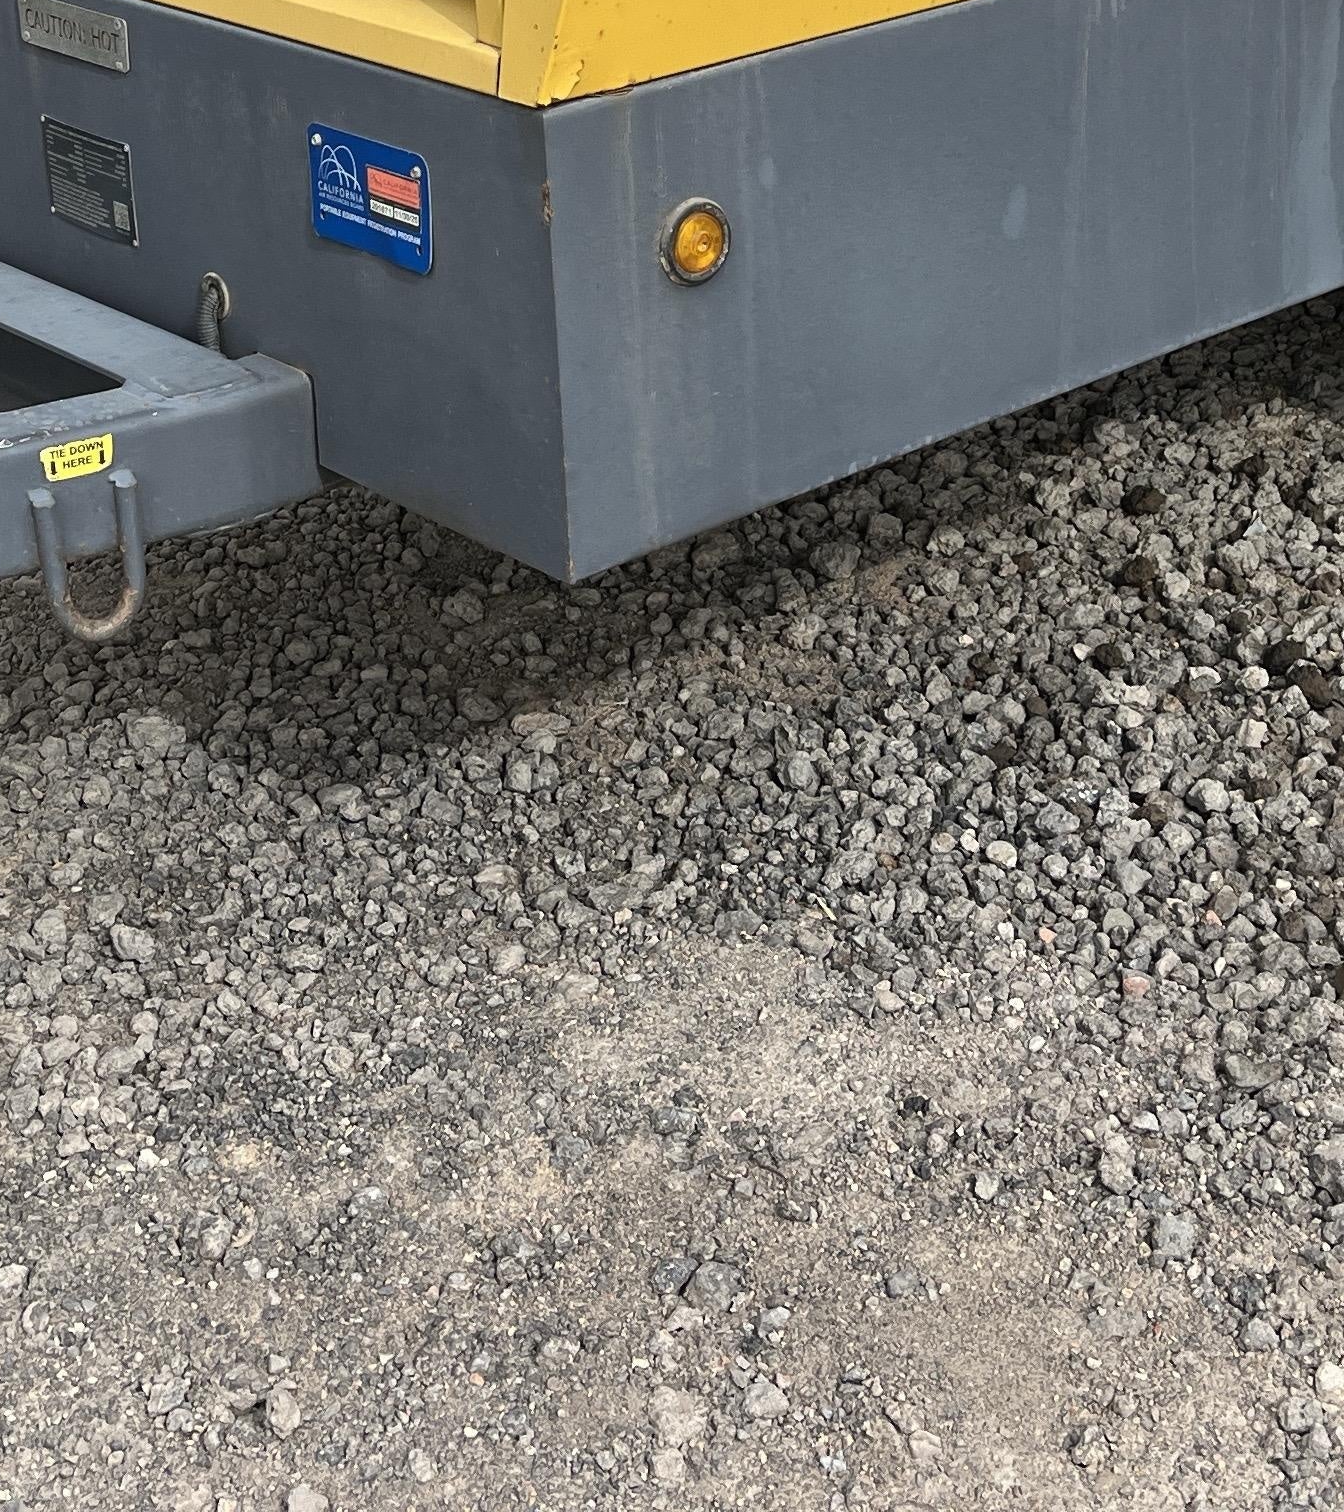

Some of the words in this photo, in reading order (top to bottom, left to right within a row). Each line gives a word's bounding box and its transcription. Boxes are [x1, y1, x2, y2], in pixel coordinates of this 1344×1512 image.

[25, 8, 87, 45] CAUTION:
[90, 28, 120, 54] HOT
[317, 180, 364, 204] CALIFORNIA
[50, 449, 66, 459] TIE
[69, 441, 104, 456] DOWN
[63, 456, 93, 469] HERE
